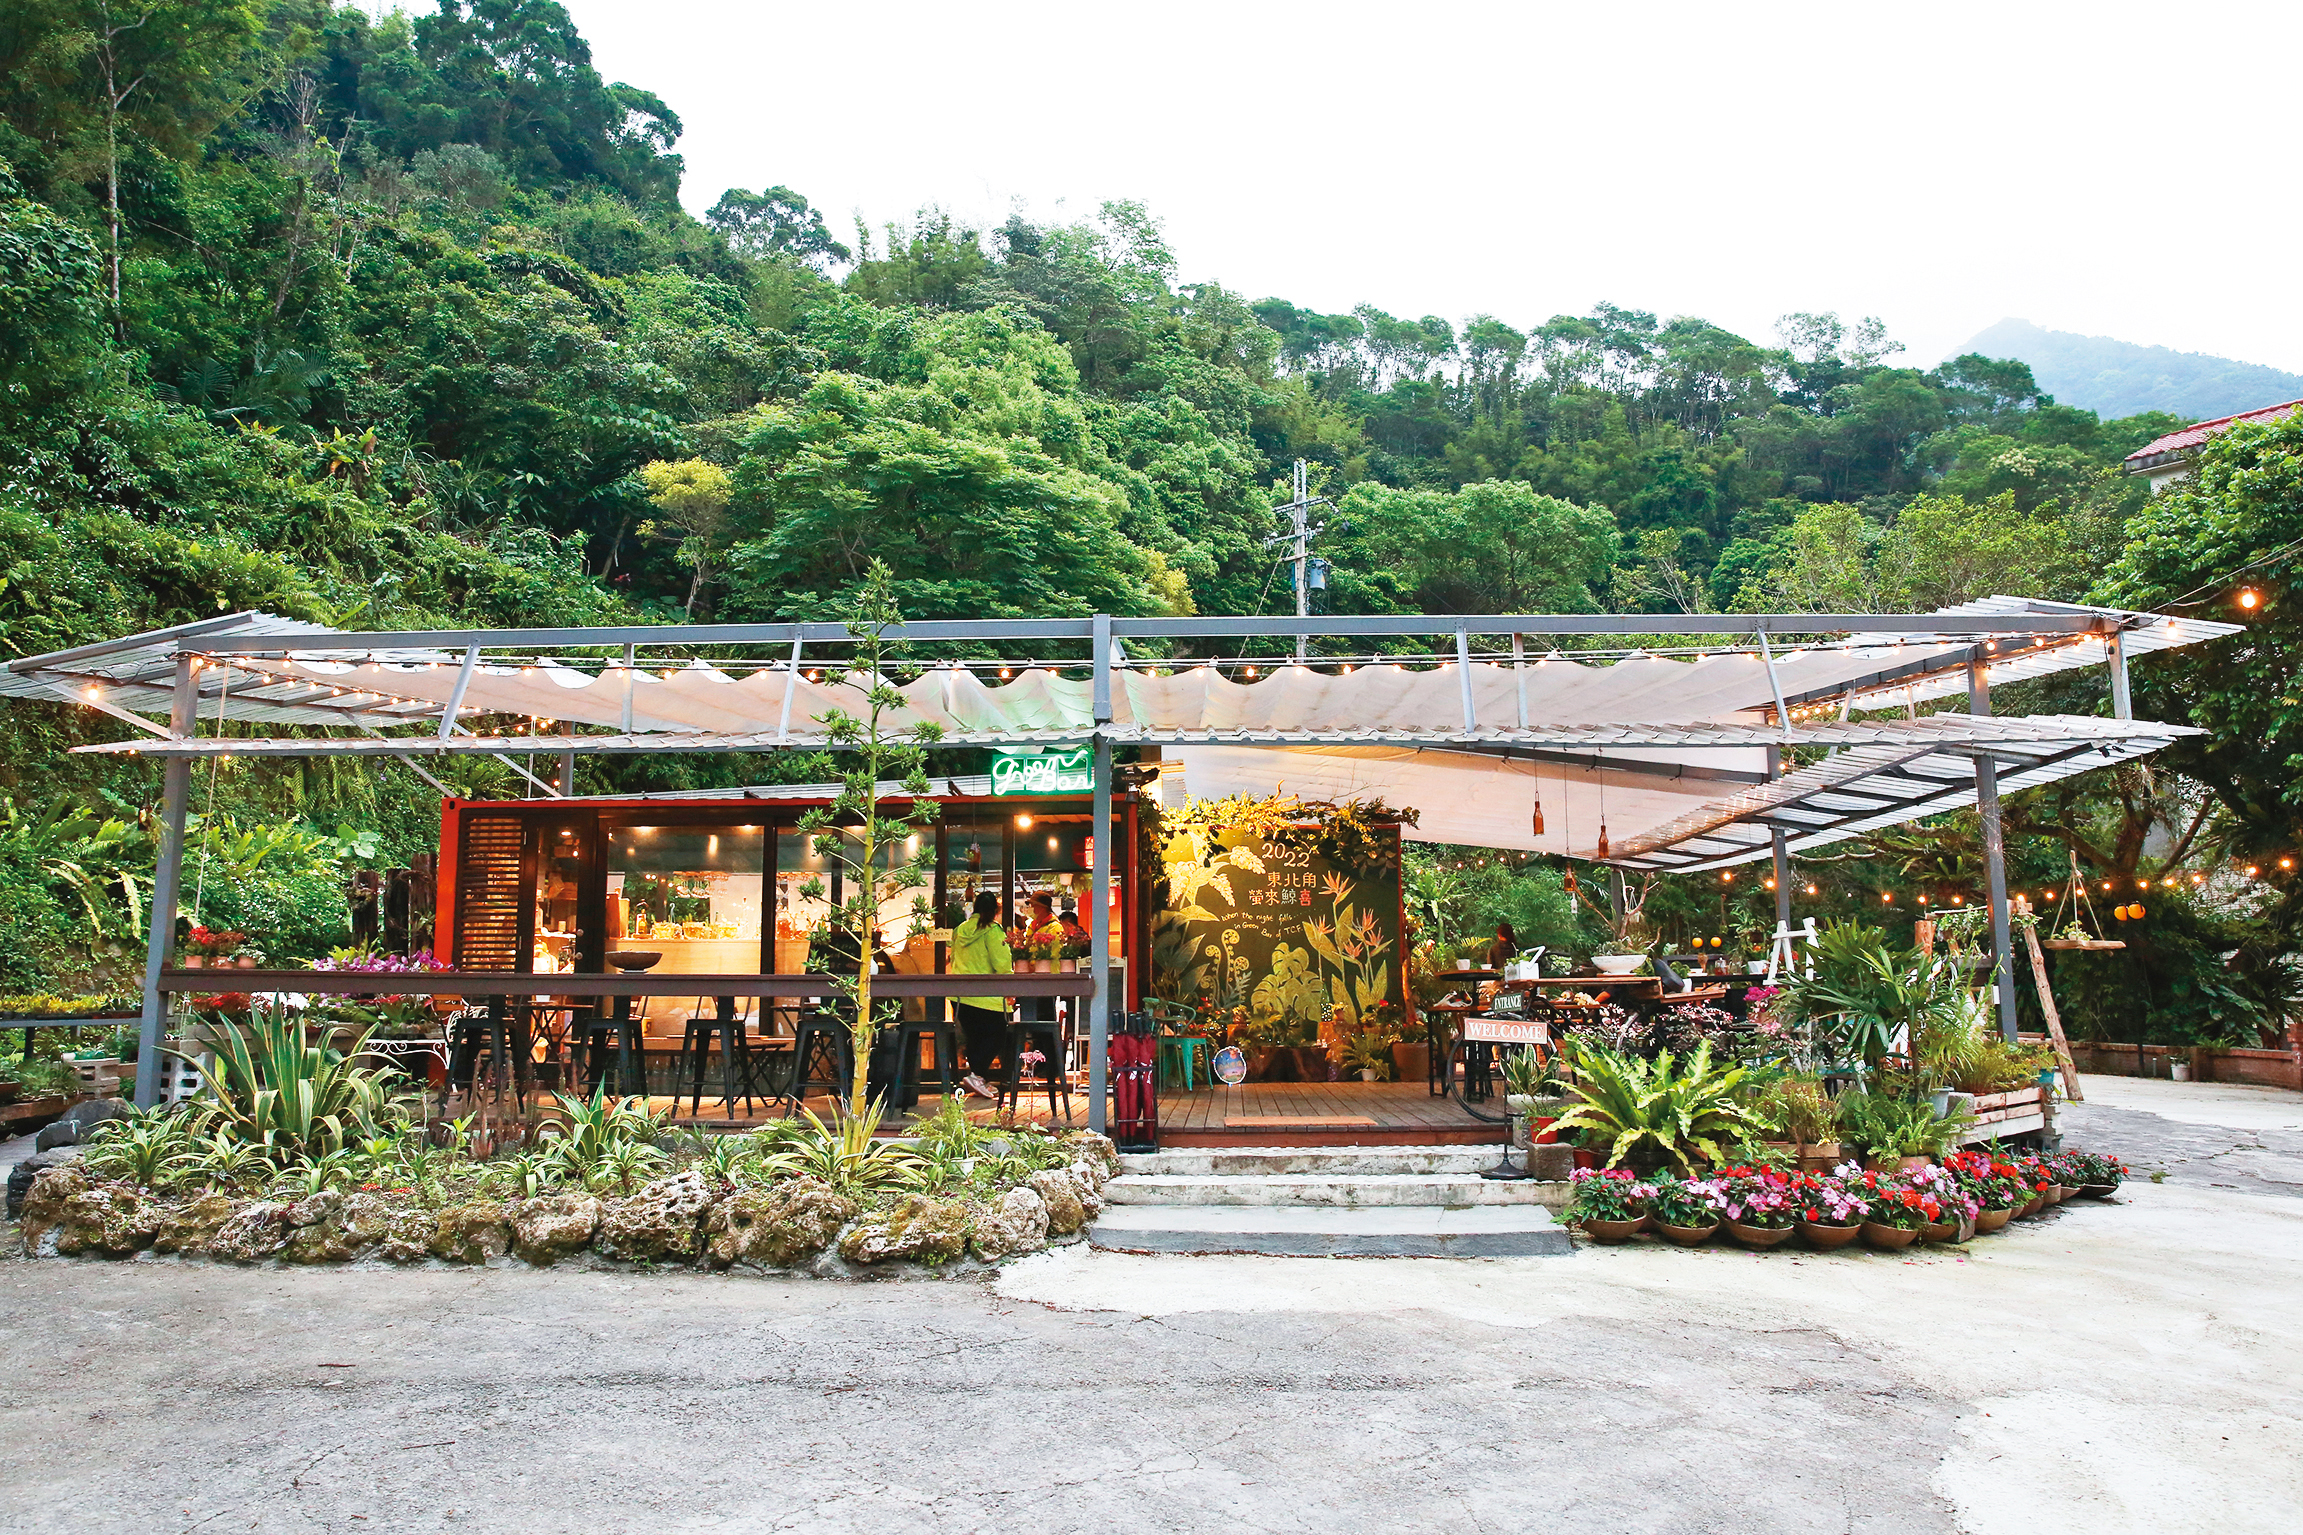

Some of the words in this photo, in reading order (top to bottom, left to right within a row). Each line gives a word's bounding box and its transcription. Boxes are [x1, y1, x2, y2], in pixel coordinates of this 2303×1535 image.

[1261, 842, 1310, 868] 2022
[1267, 871, 1317, 888] 東北角
[1248, 888, 1312, 906] 螢來鯨喜
[1241, 912, 1254, 920] the
[1256, 914, 1274, 924] night
[1242, 921, 1259, 930] Green
[1275, 929, 1282, 941] of
[1494, 995, 1521, 1009] ENTRANCE
[1468, 1022, 1543, 1039] WELCOME
